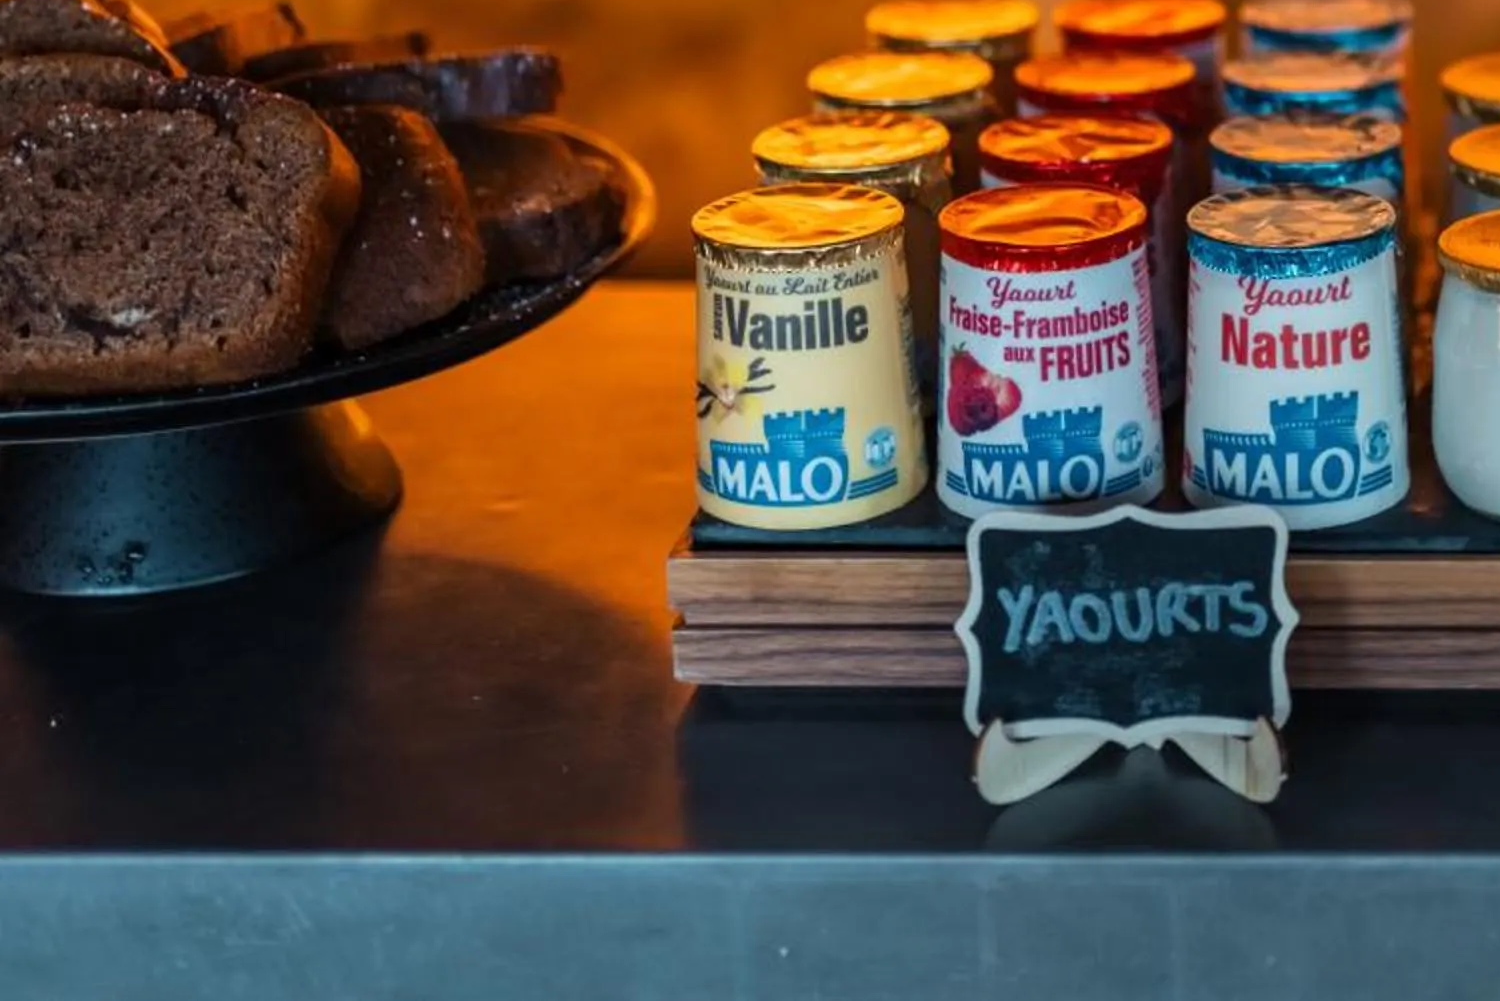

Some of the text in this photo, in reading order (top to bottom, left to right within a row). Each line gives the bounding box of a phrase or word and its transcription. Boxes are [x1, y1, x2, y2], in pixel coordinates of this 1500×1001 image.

[705, 265, 879, 296] Yaourt au Lait Entier
[986, 276, 1077, 309] Yaourt
[1238, 275, 1352, 314] Yaourt
[725, 296, 868, 351] Vanille
[949, 297, 1129, 339] Fraise-Framboise
[1003, 332, 1131, 382] aux FRUITS
[1221, 313, 1371, 370] Nature
[716, 455, 844, 501] MALO
[969, 454, 1098, 500] MALO
[1211, 446, 1355, 500] MALO
[996, 581, 1268, 653] YAOURTS
